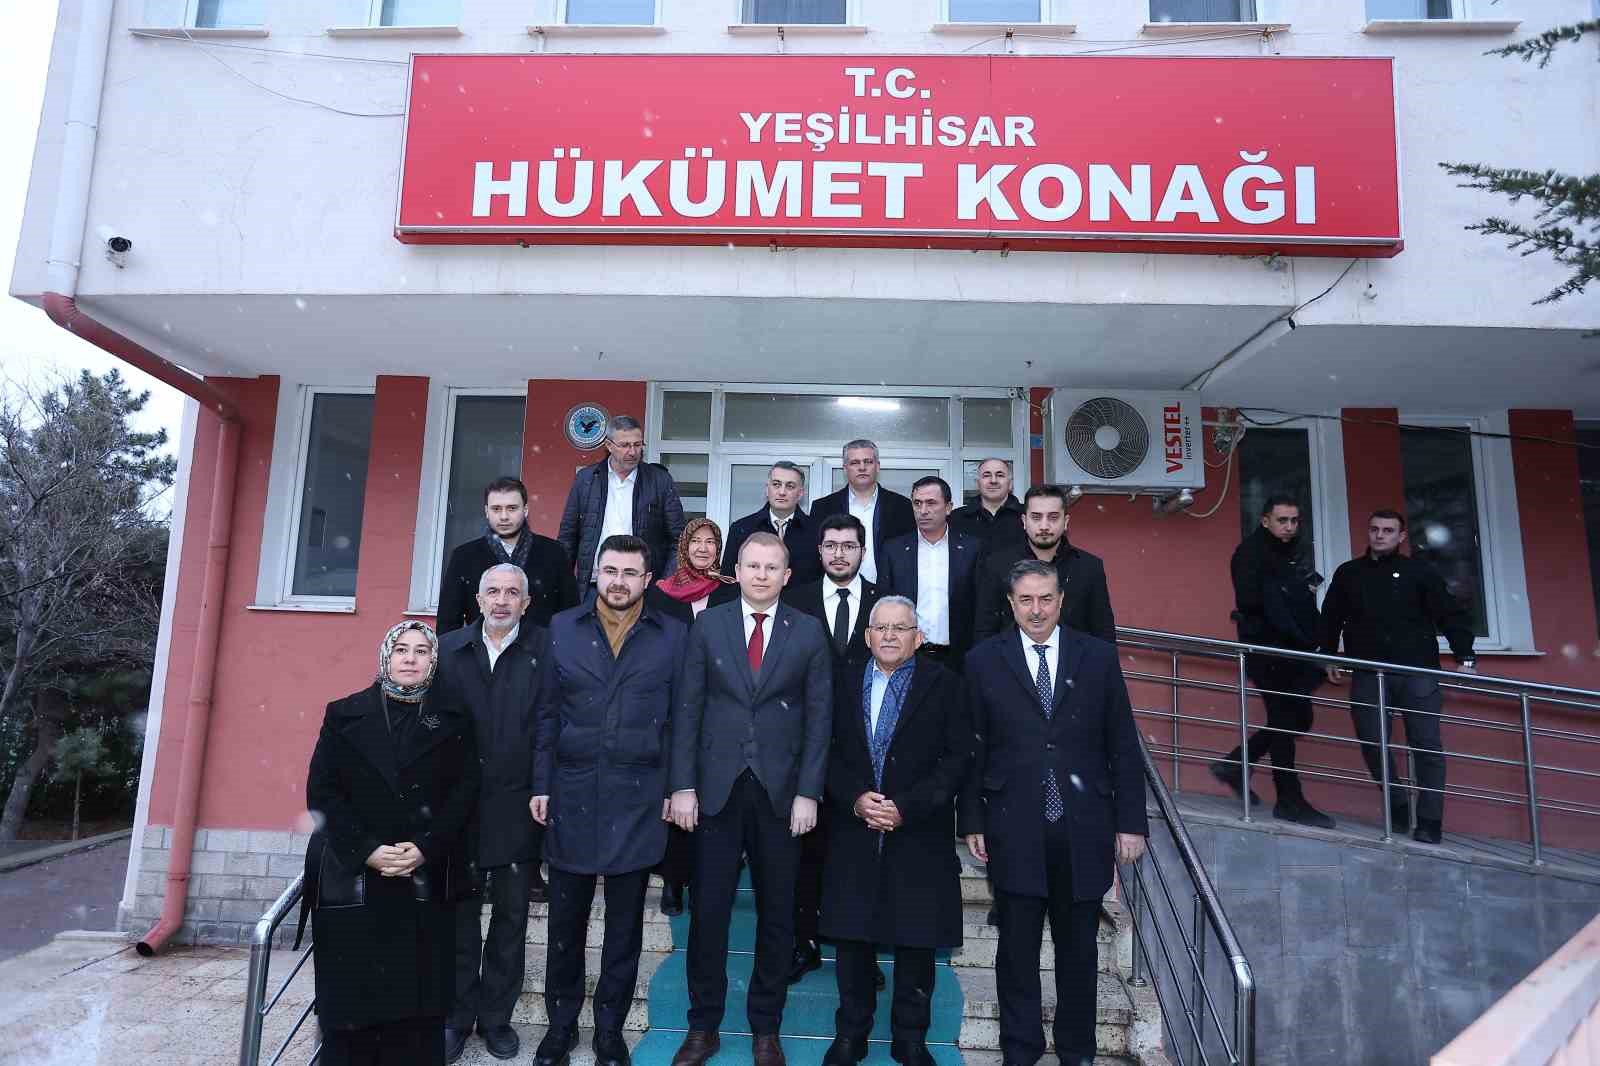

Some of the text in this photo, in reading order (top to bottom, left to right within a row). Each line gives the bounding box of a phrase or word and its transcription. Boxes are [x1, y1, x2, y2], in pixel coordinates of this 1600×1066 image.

[844, 67, 932, 99] T.C.
[739, 105, 1037, 152] YEŞİLHİSAR
[472, 147, 1317, 225] HÜKÜMET KONAĞI
[1163, 402, 1184, 475] VESTEL
